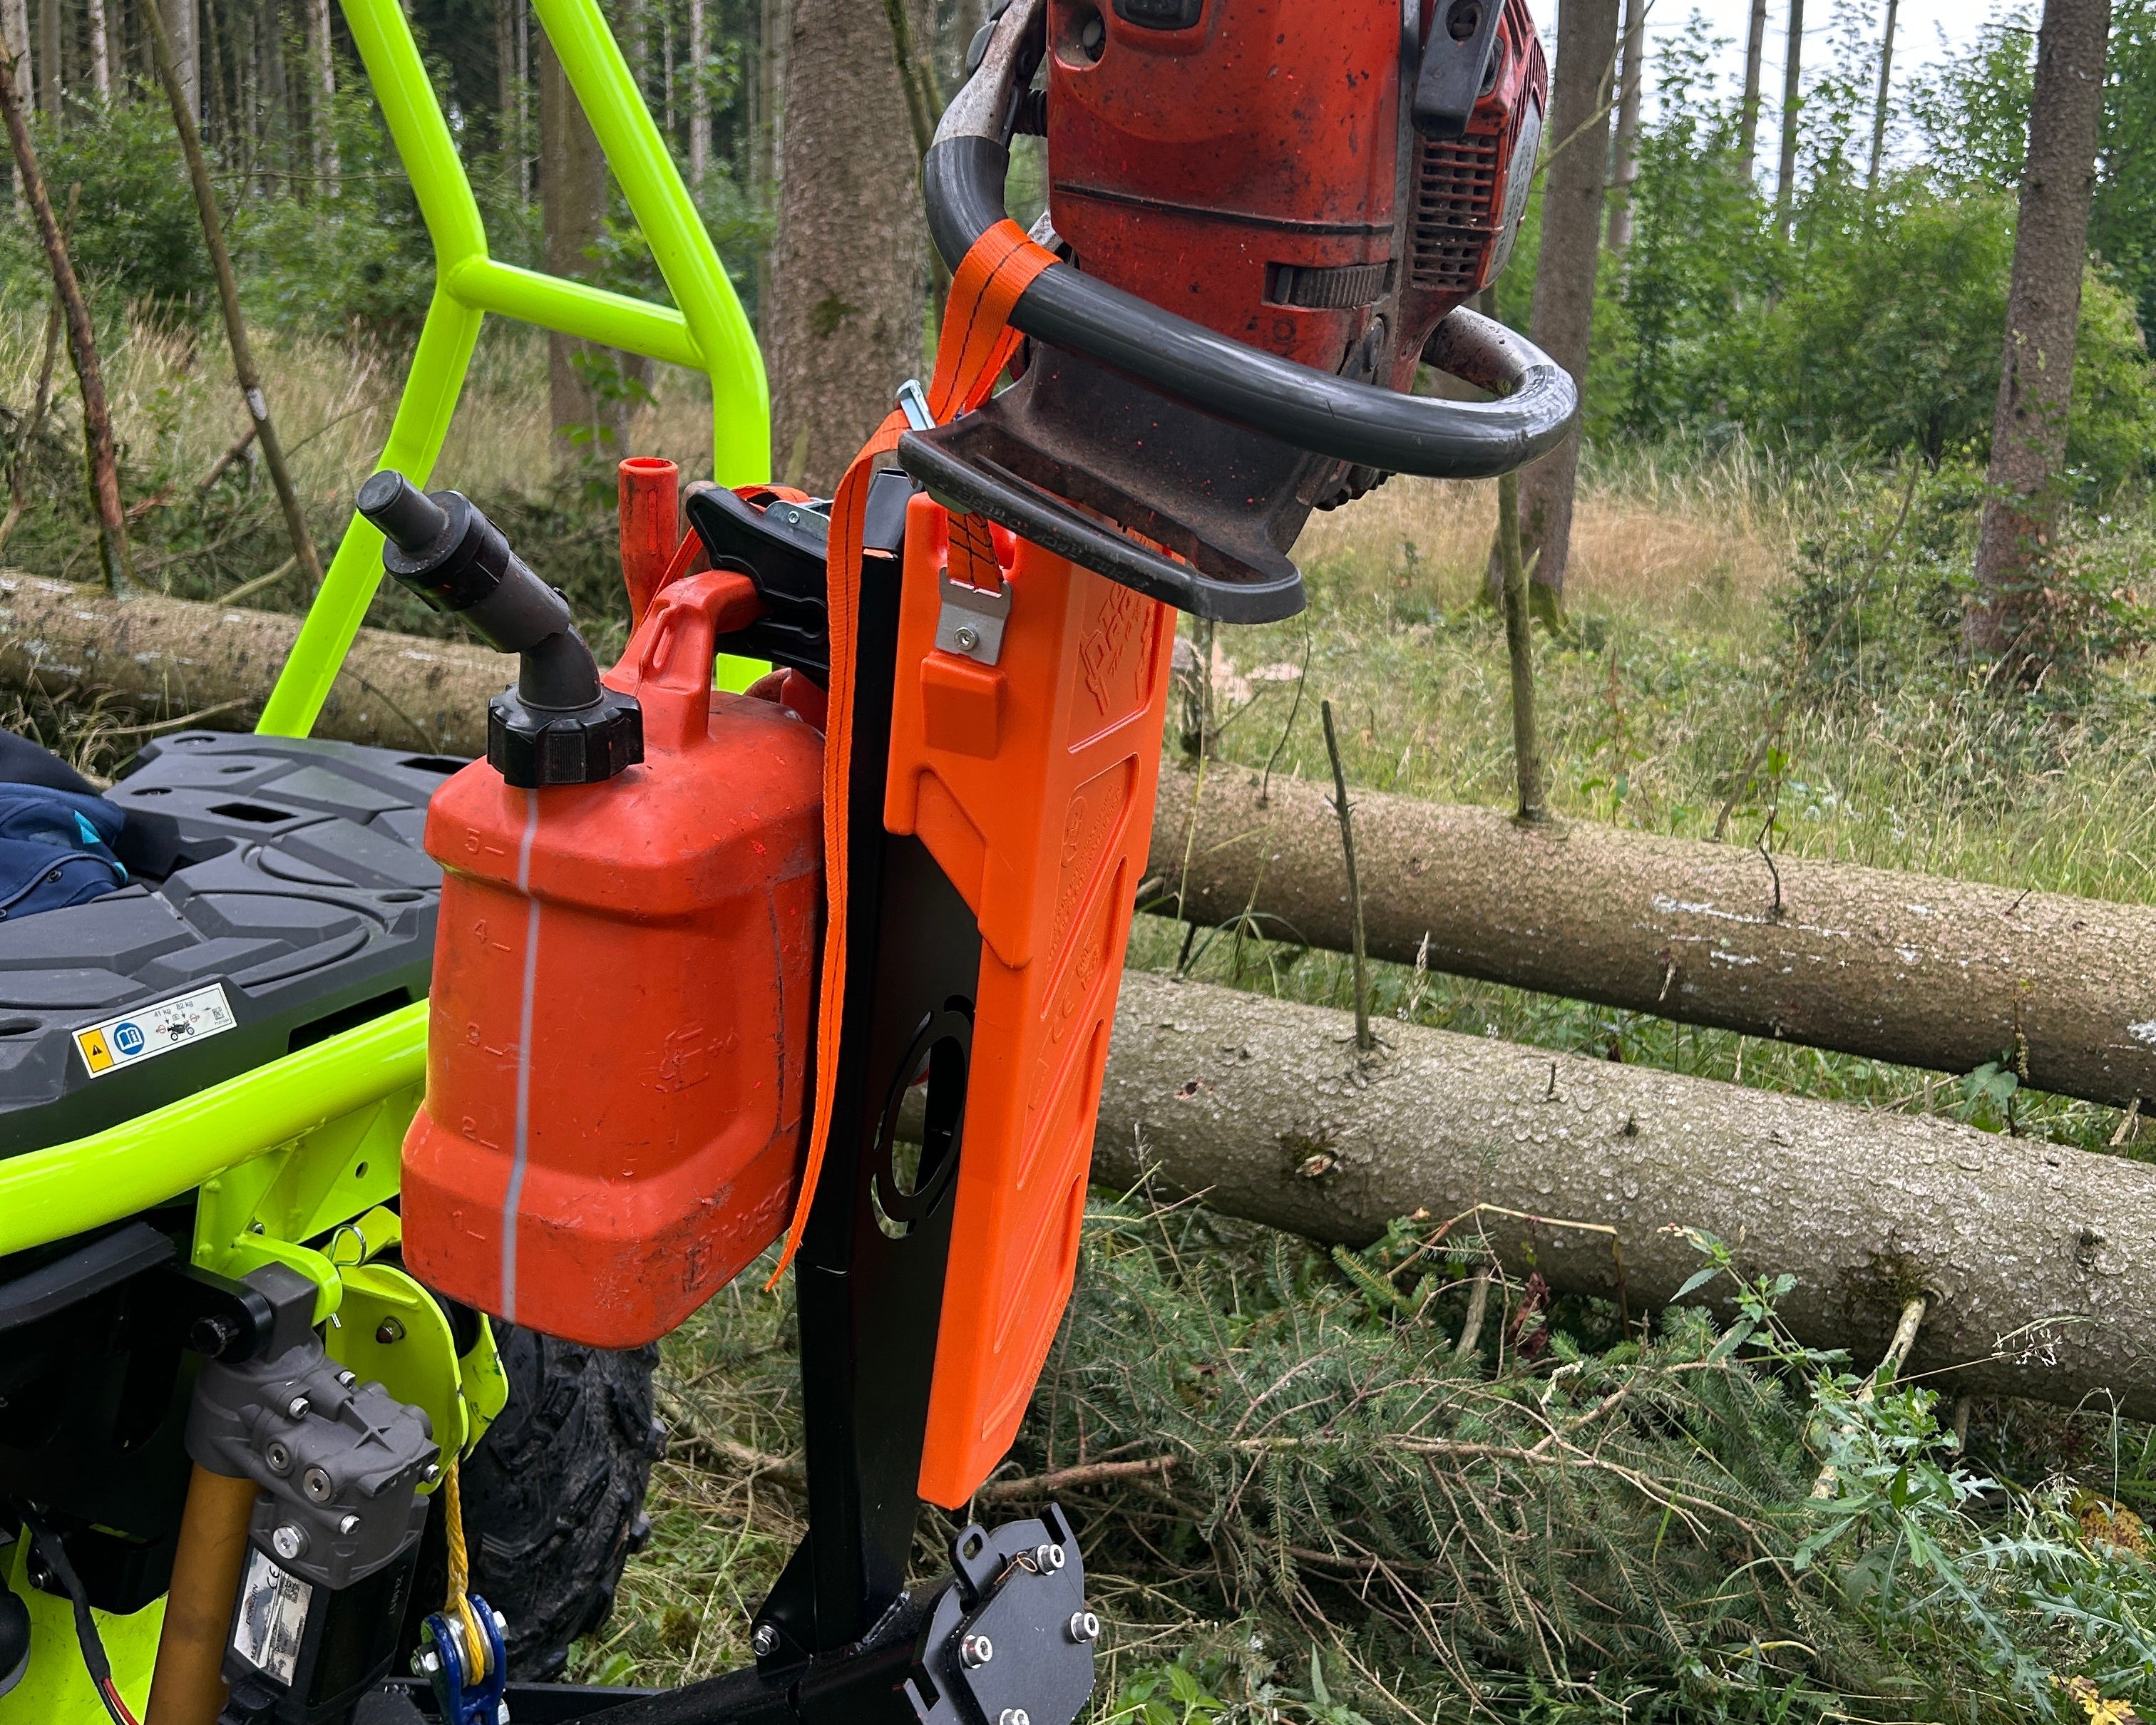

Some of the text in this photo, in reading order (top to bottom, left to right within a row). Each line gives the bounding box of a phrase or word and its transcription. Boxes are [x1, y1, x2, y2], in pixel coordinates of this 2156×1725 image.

[465, 827, 481, 855] 5
[473, 918, 488, 944] 4
[465, 1021, 481, 1046] 3
[462, 1116, 477, 1140] 2
[451, 1210, 463, 1232] 1
[267, 1565, 280, 1590] CE
